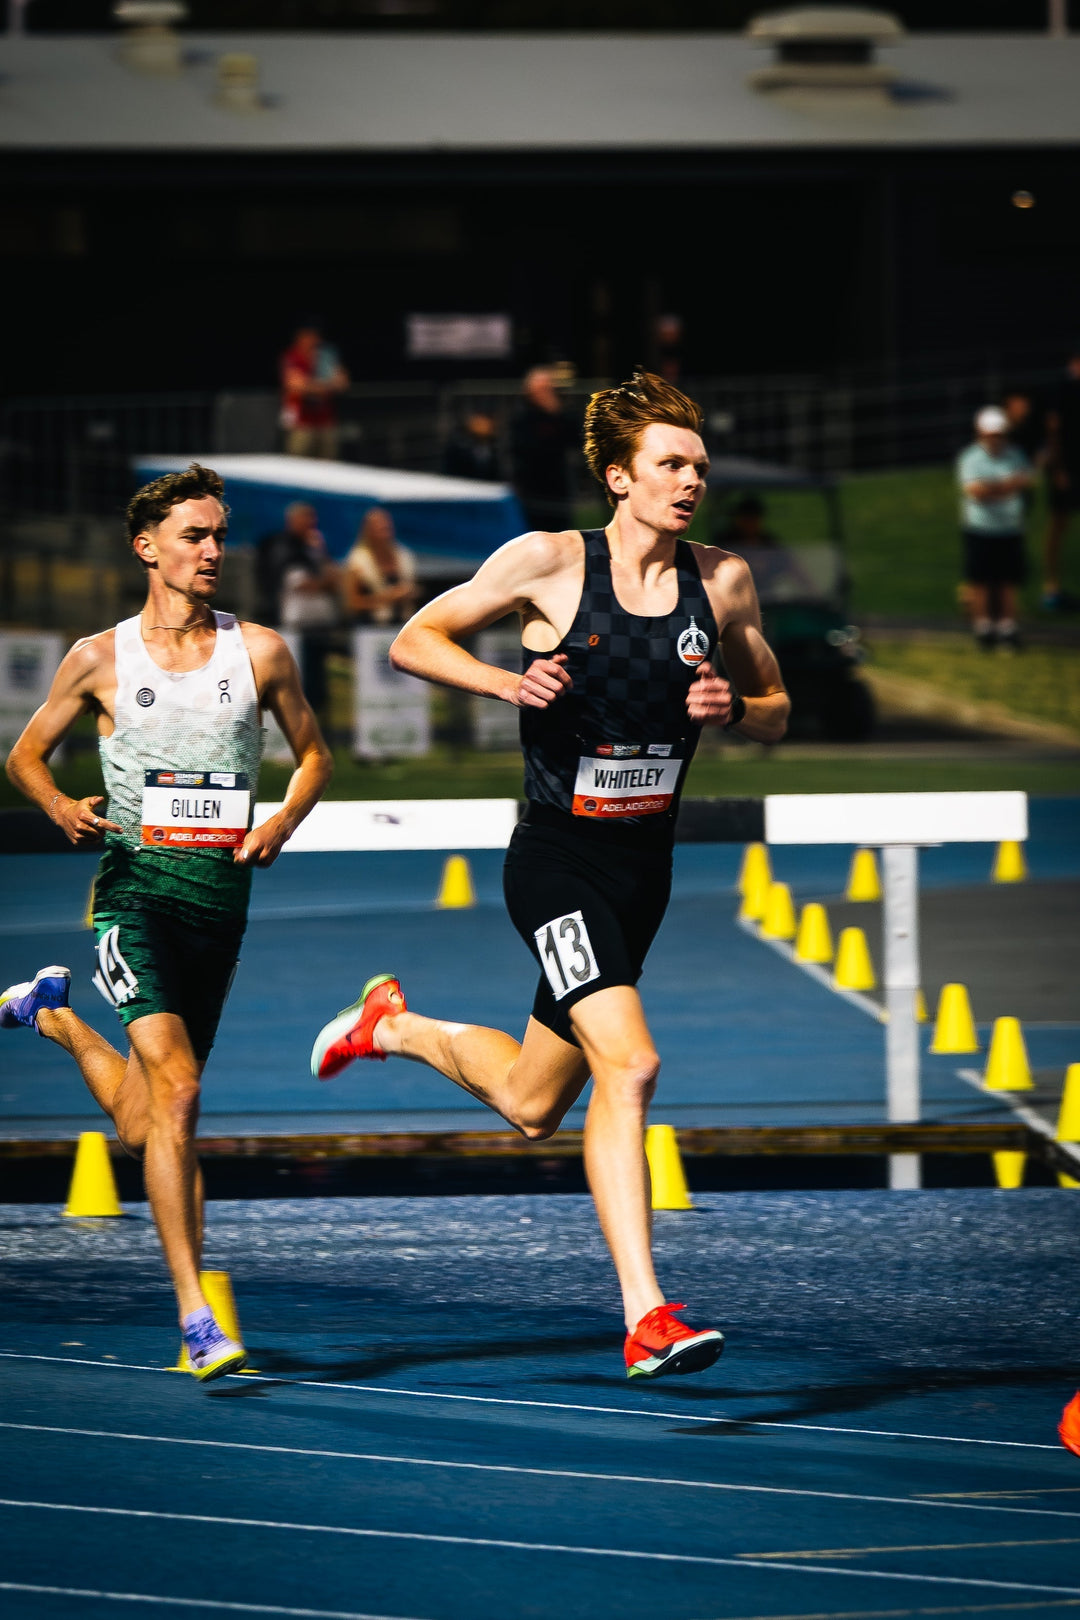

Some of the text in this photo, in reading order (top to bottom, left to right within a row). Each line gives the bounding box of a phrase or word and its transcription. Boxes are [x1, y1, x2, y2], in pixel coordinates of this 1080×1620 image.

[594, 768, 665, 789] WHITELEY
[171, 798, 221, 818] GILLEN
[545, 917, 591, 991] 13
